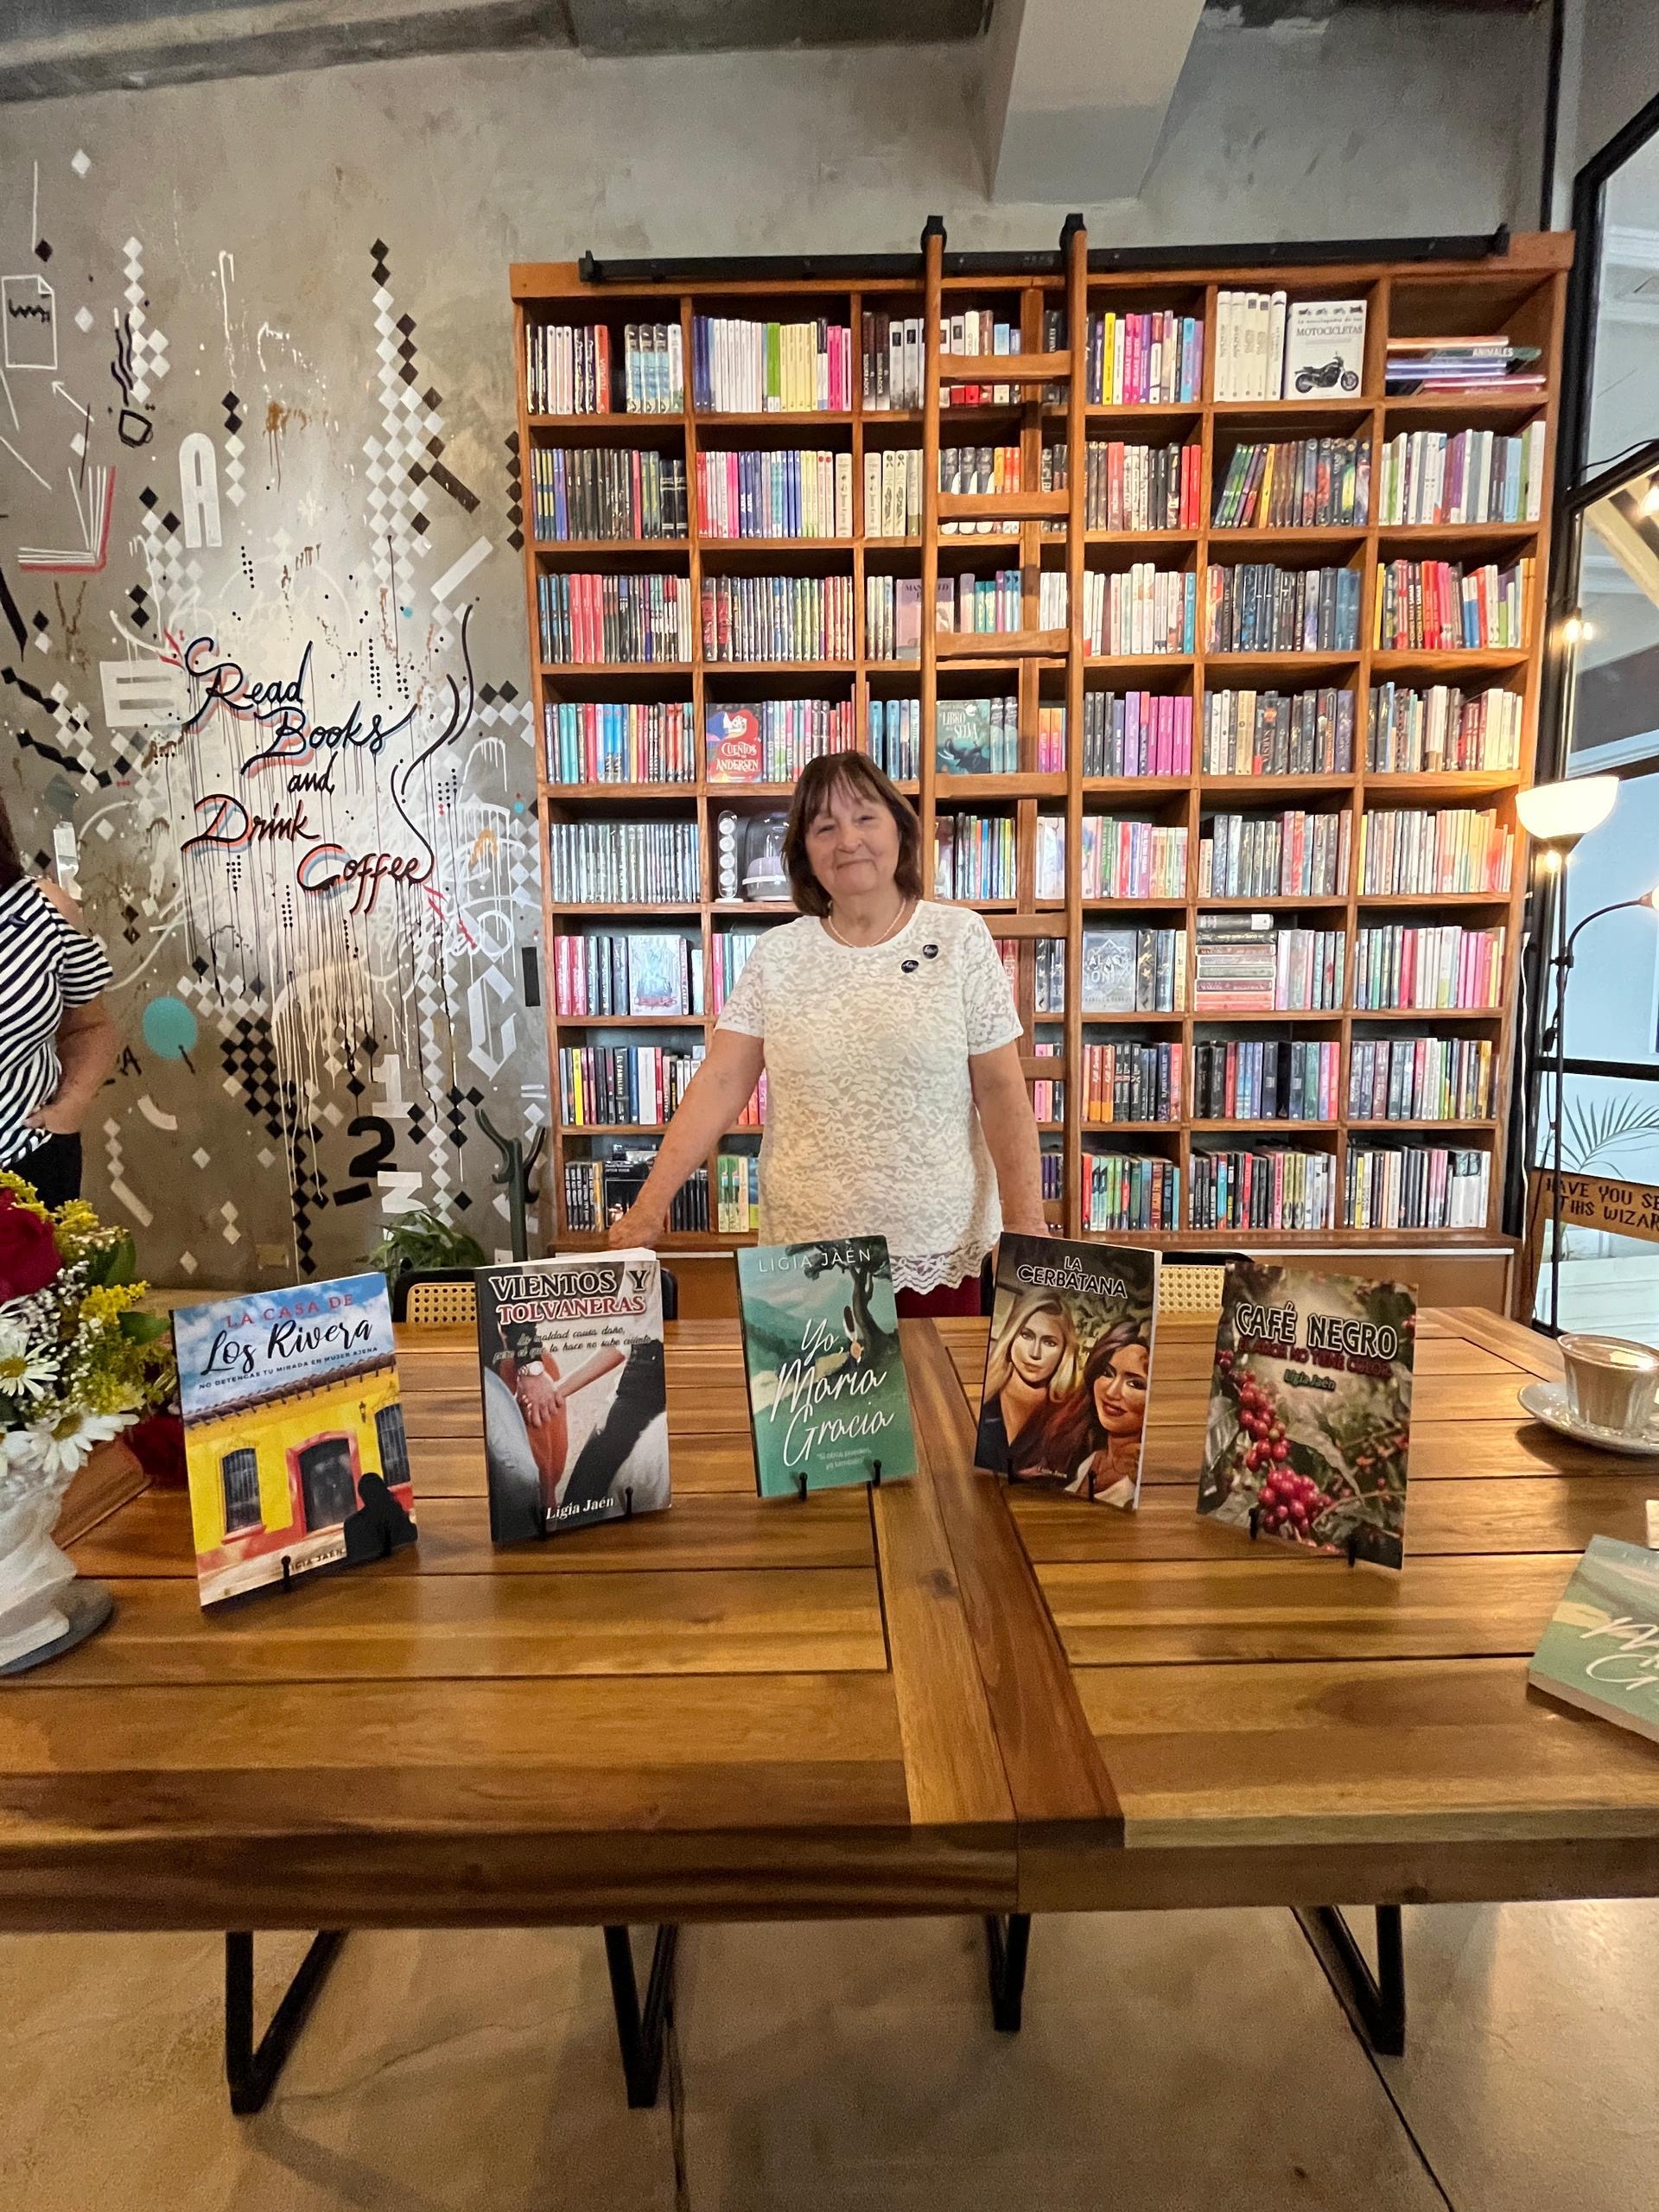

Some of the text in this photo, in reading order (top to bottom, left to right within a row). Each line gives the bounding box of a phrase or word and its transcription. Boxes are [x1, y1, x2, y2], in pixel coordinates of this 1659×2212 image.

[1297, 325, 1363, 336] MOTOCICLETAS
[1472, 347, 1514, 358] ANIMALES
[183, 637, 313, 736] Read
[241, 701, 418, 776] Books
[721, 741, 757, 758] CUENTOS
[288, 751, 337, 793] and
[715, 759, 760, 772] ANDERSEN
[181, 794, 321, 852] Drink
[297, 843, 435, 914] Coffee
[347, 1116, 397, 1178] 2
[1599, 1185, 1632, 1205] YOU
[759, 1248, 870, 1273] LIGIA JAÉN
[1064, 1255, 1083, 1272] LA
[489, 1270, 650, 1301] VIENTOS Y
[1017, 1264, 1128, 1299] CERBATANA
[226, 1294, 353, 1328] LA CASA DE
[496, 1295, 647, 1325] TOLVANERAS
[531, 1328, 570, 1344] maldad
[572, 1329, 597, 1338] causa
[550, 1341, 559, 1354] la
[563, 1338, 584, 1351] hace
[587, 1339, 597, 1348] no
[601, 1336, 620, 1348] sabe
[801, 1319, 843, 1366] Yo,
[1236, 1300, 1398, 1360] CAFÉ NEGRO
[200, 1319, 373, 1376] Los Rivera
[276, 1360, 308, 1374] MIRADA
[311, 1357, 322, 1366] EN
[324, 1352, 350, 1363] MUJER
[353, 1345, 378, 1357] AJENA
[1290, 1346, 1310, 1364] NO
[1312, 1349, 1345, 1371] TIENE
[1346, 1355, 1394, 1379] COLOR
[1284, 1369, 1337, 1392] Ligia Jaén
[784, 1402, 894, 1466] Gracia
[546, 1496, 614, 1520] Ligia Jaén
